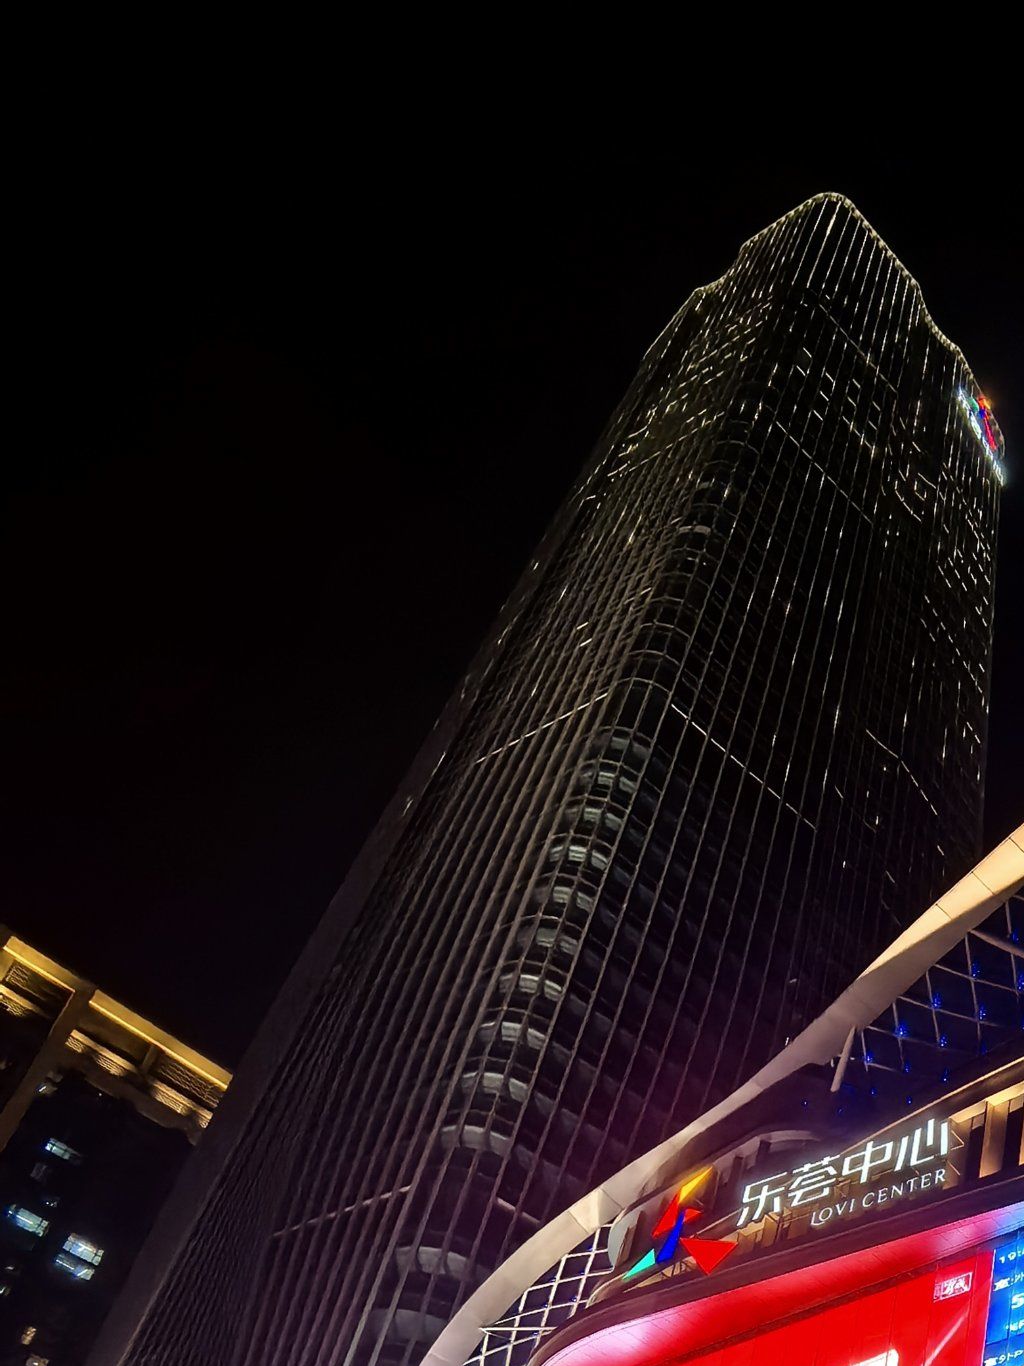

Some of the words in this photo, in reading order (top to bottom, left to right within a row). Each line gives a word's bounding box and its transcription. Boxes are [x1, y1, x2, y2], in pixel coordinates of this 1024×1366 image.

[736, 1118, 949, 1227] 乐荟中心
[809, 1198, 857, 1227] LOVI
[861, 1168, 947, 1208] CENTER
